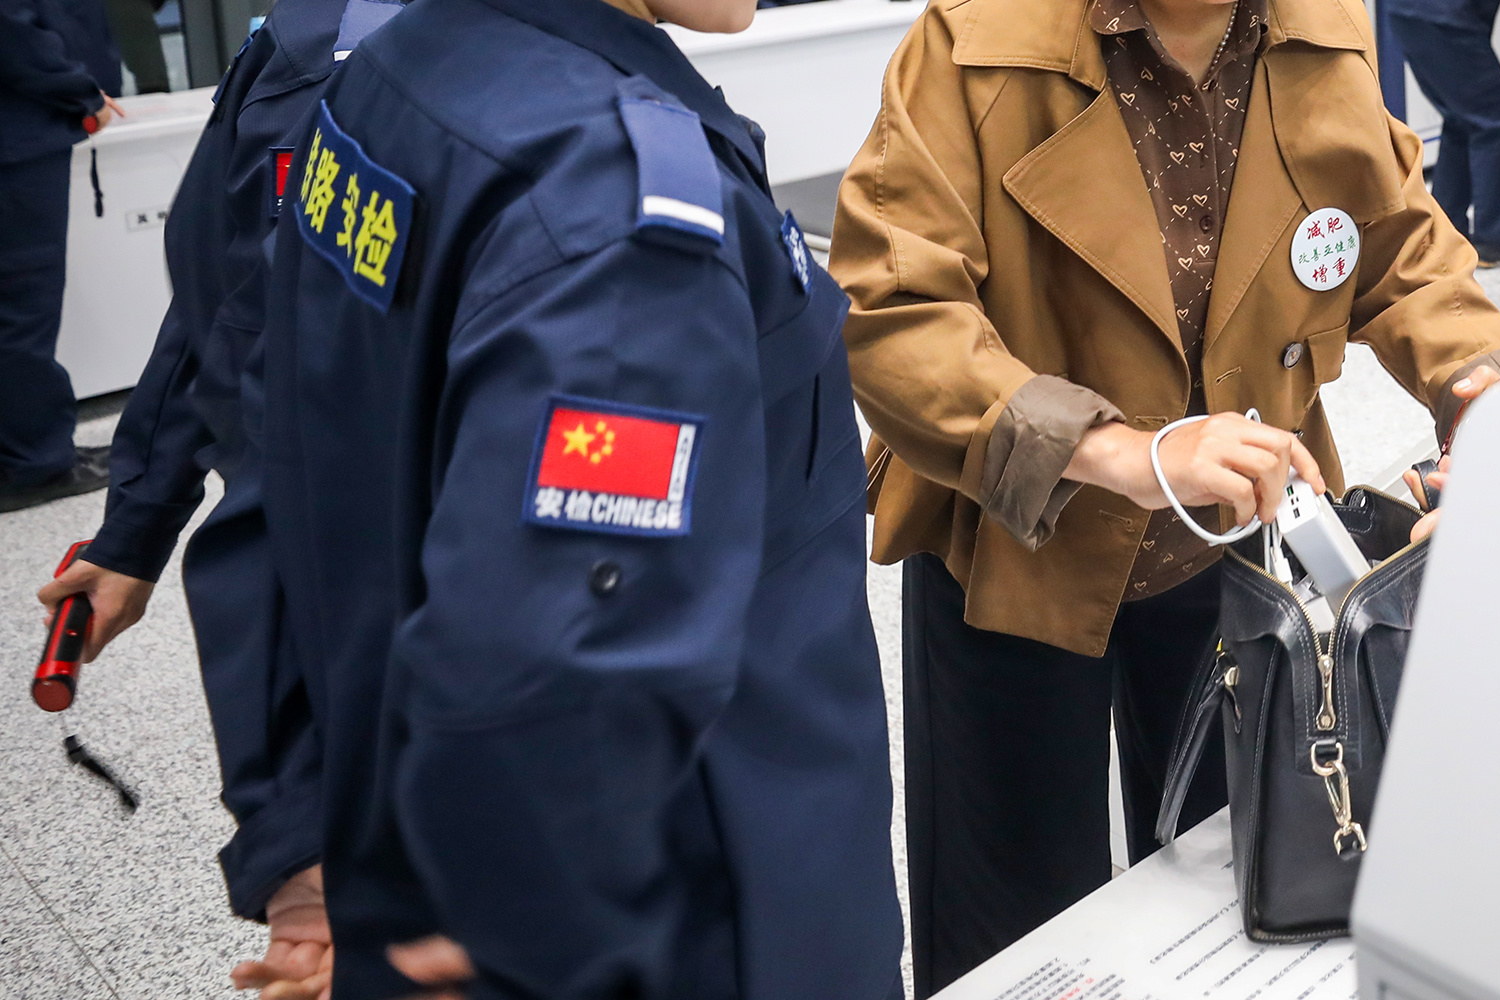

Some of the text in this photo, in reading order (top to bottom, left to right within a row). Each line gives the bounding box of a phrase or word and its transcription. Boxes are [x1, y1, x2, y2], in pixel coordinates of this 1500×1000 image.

[1307, 217, 1344, 240] 减肥
[1298, 235, 1357, 264] 改善亚健康
[1312, 257, 1346, 283] 增重
